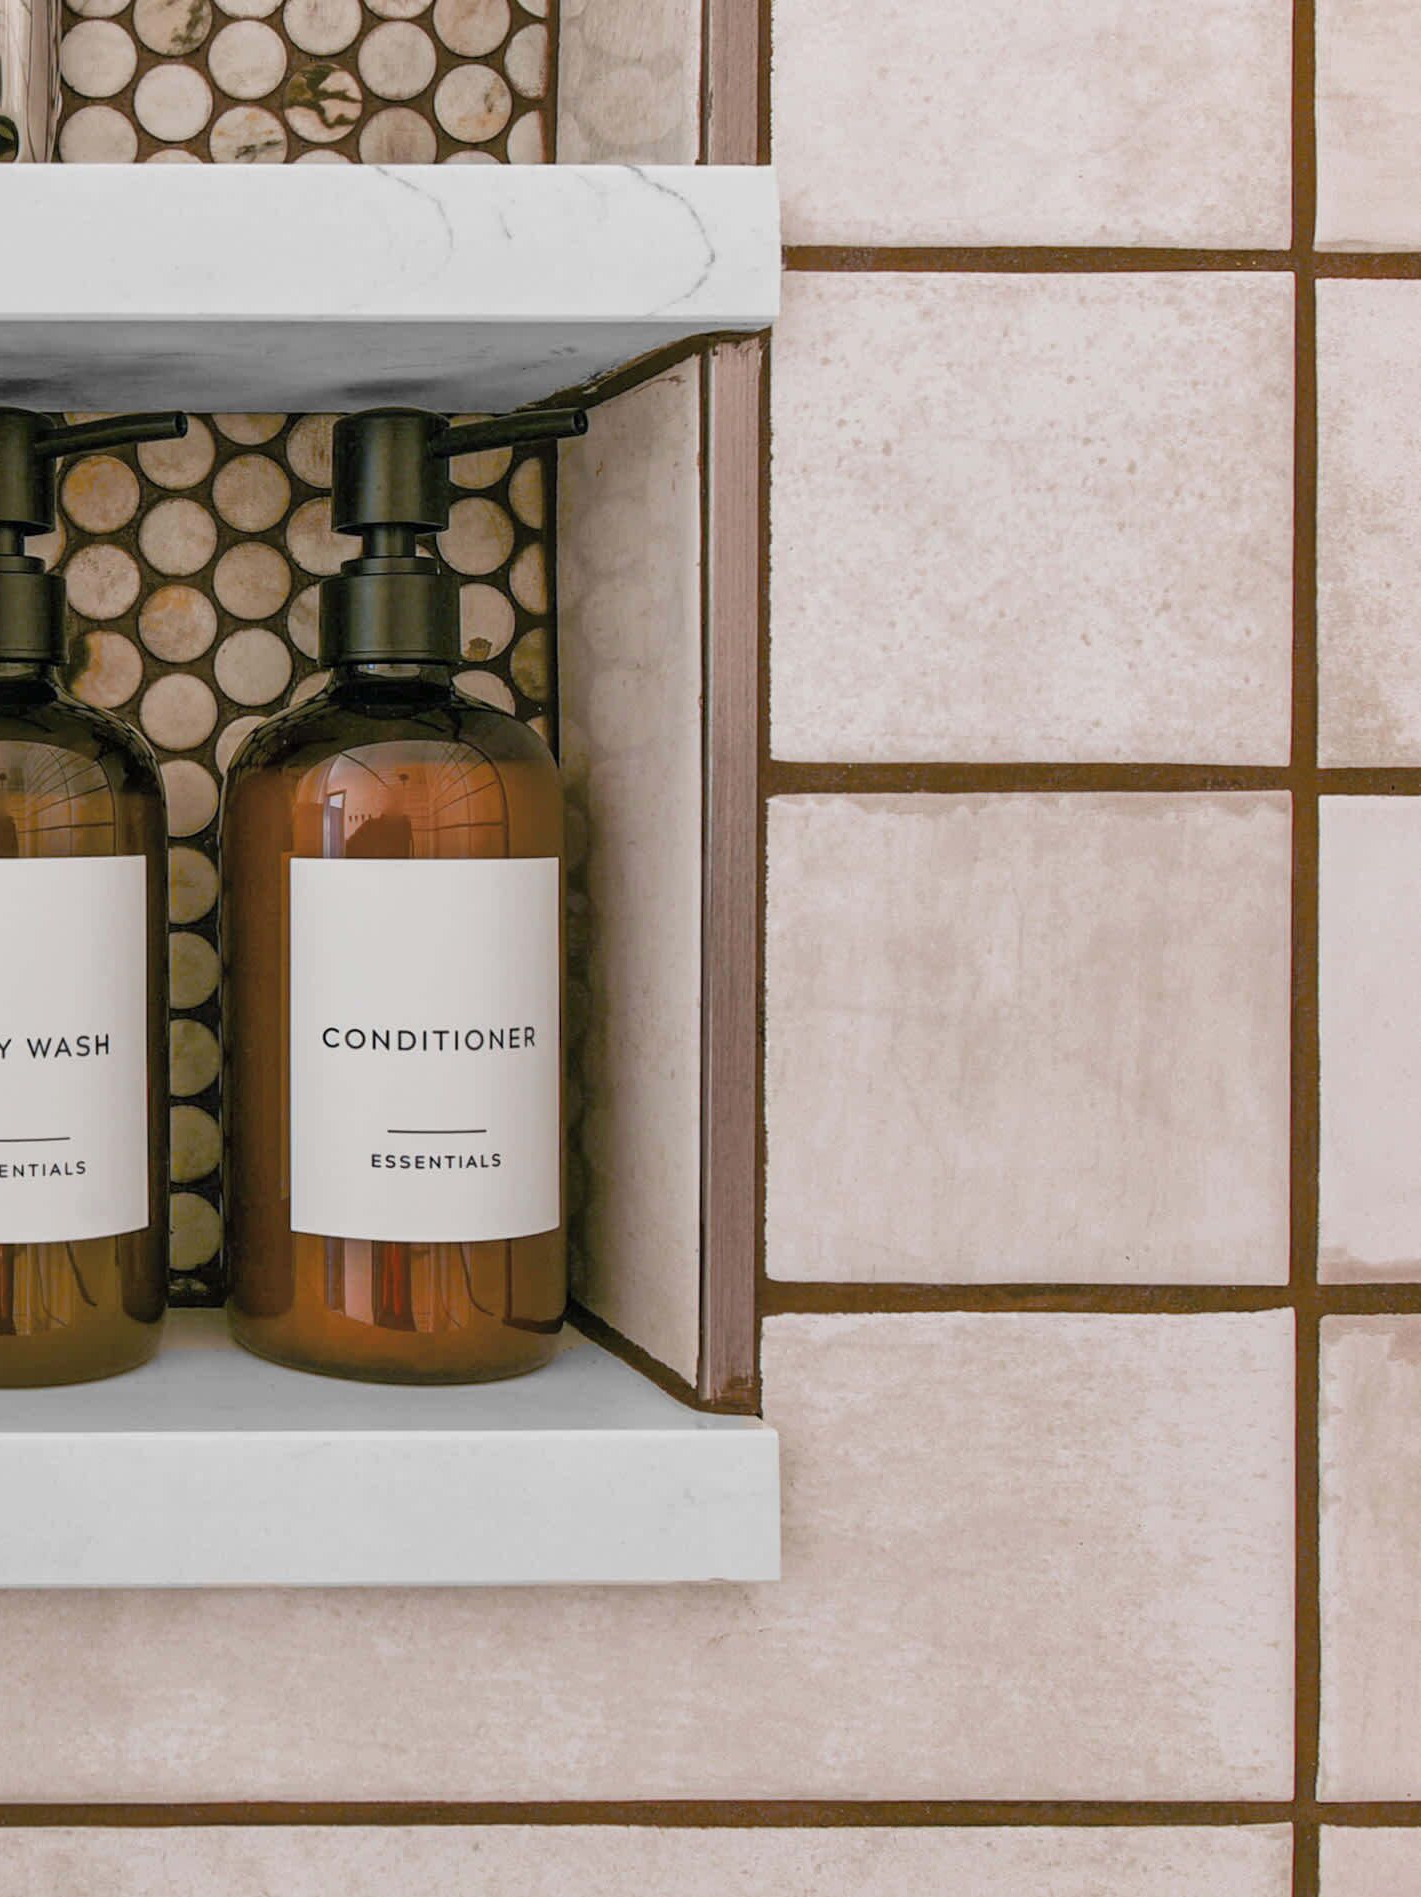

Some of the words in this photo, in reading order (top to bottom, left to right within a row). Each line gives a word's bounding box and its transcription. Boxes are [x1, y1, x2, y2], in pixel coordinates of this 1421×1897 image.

[26, 1033, 110, 1058] WASH
[322, 1025, 536, 1052] CONDITIONER
[371, 1152, 502, 1170] ESSENTIALS
